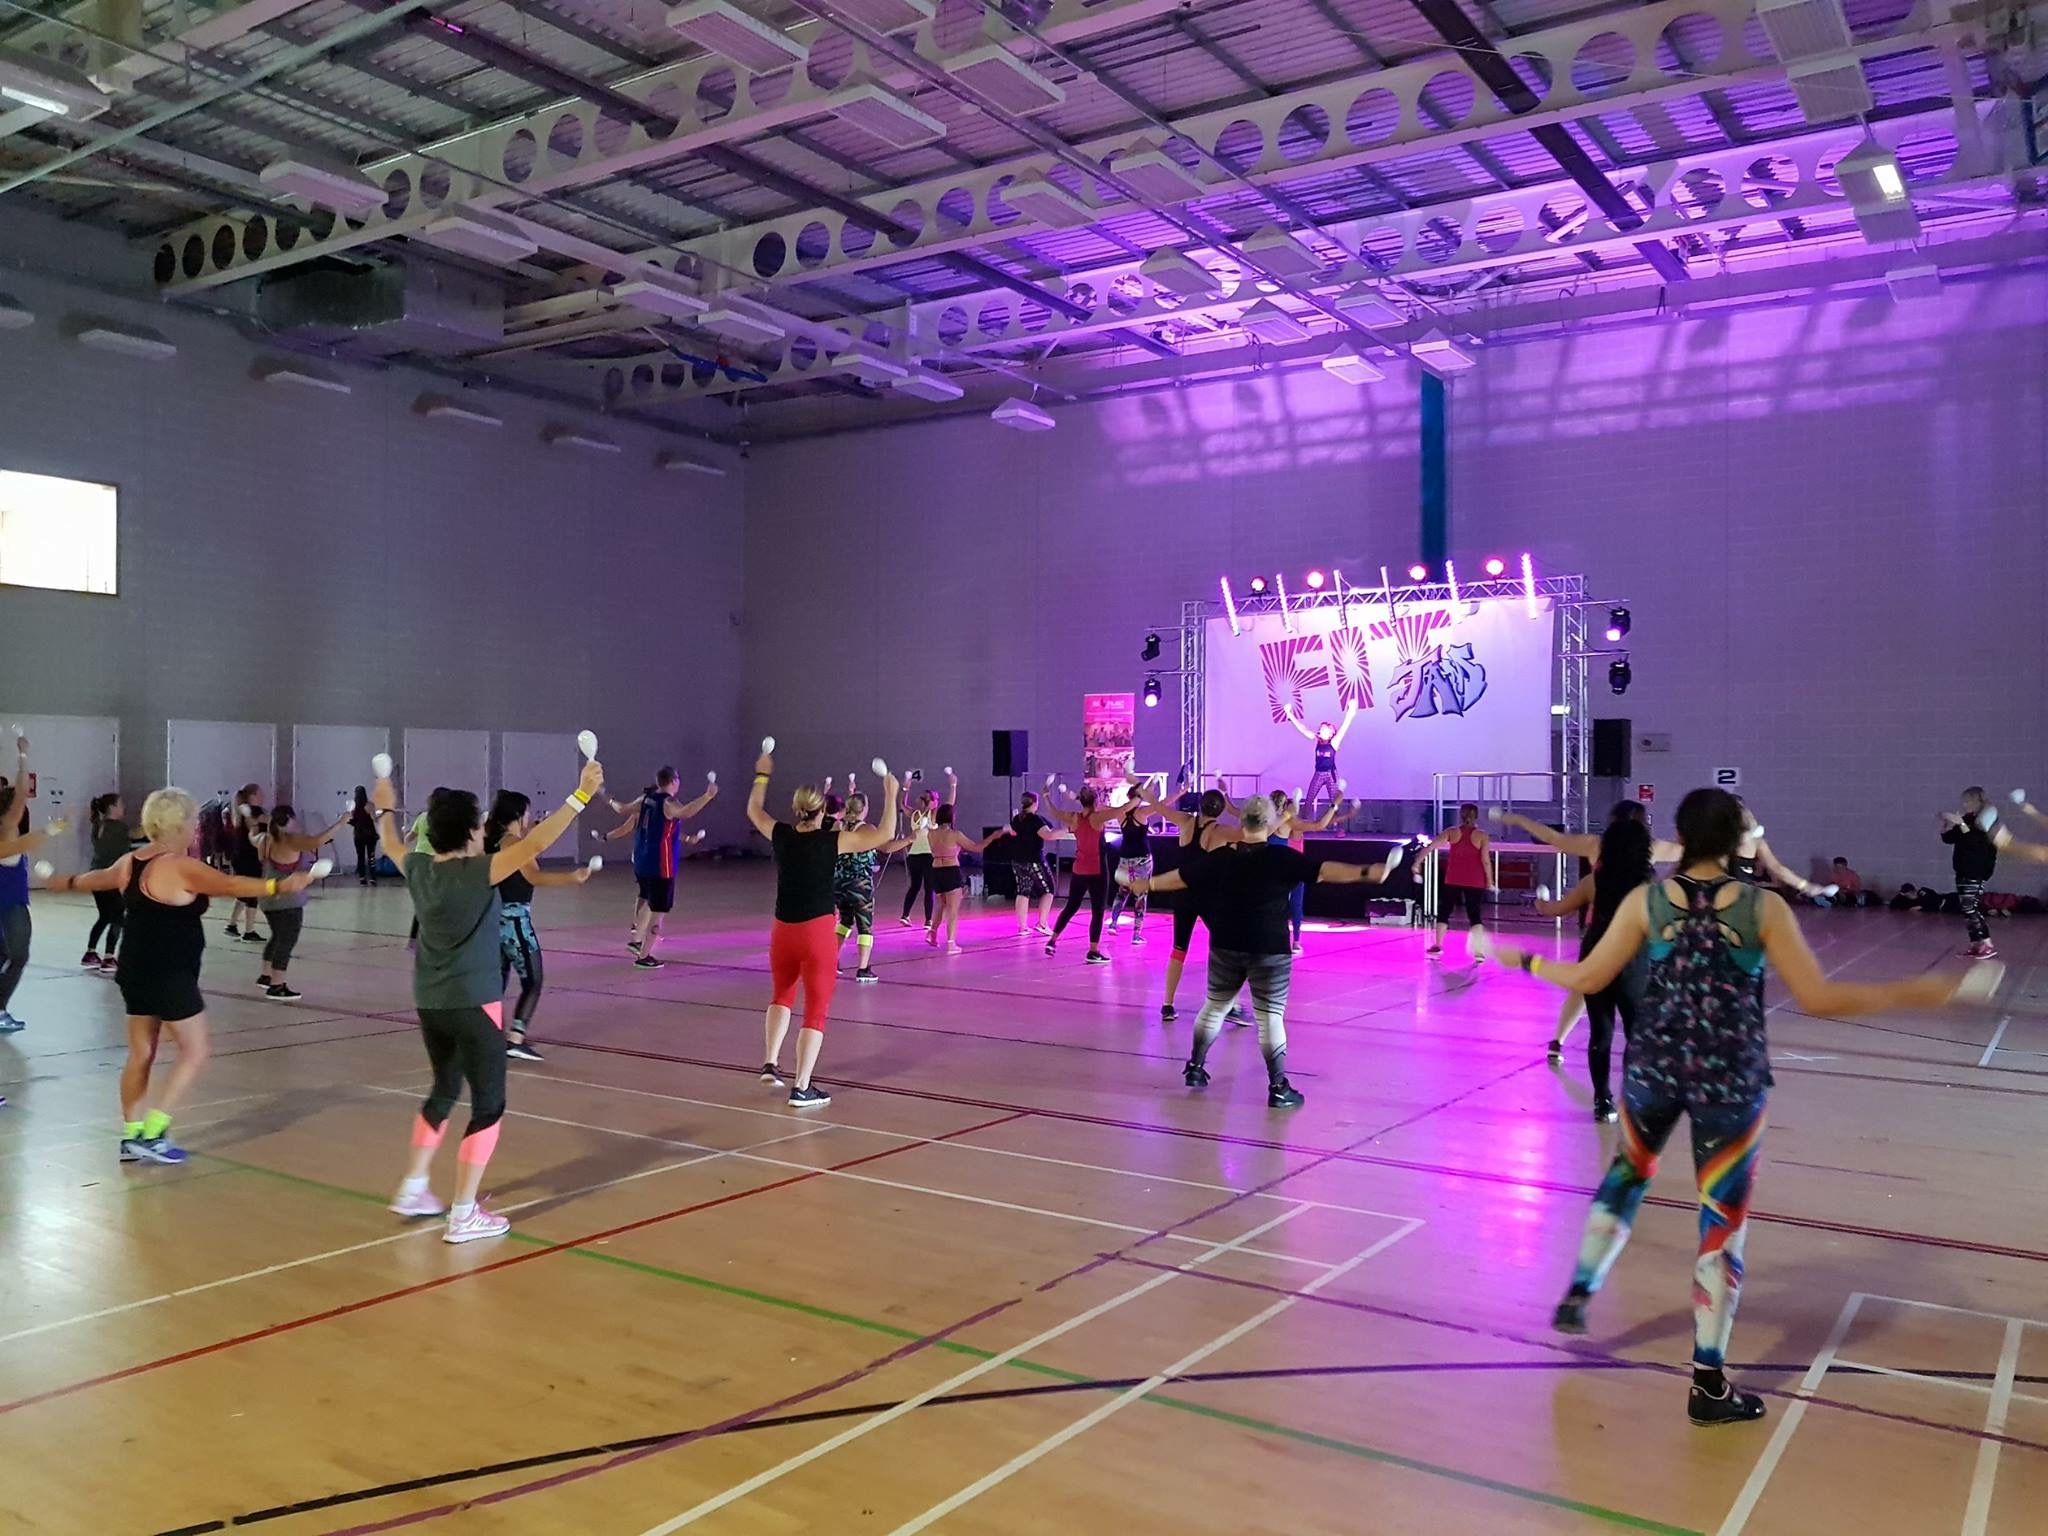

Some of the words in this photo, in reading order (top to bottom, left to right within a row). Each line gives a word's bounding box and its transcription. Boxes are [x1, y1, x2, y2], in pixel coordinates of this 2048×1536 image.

[1259, 610, 1451, 723] FIT
[911, 770, 922, 781] 4
[1717, 770, 1736, 784] 2
